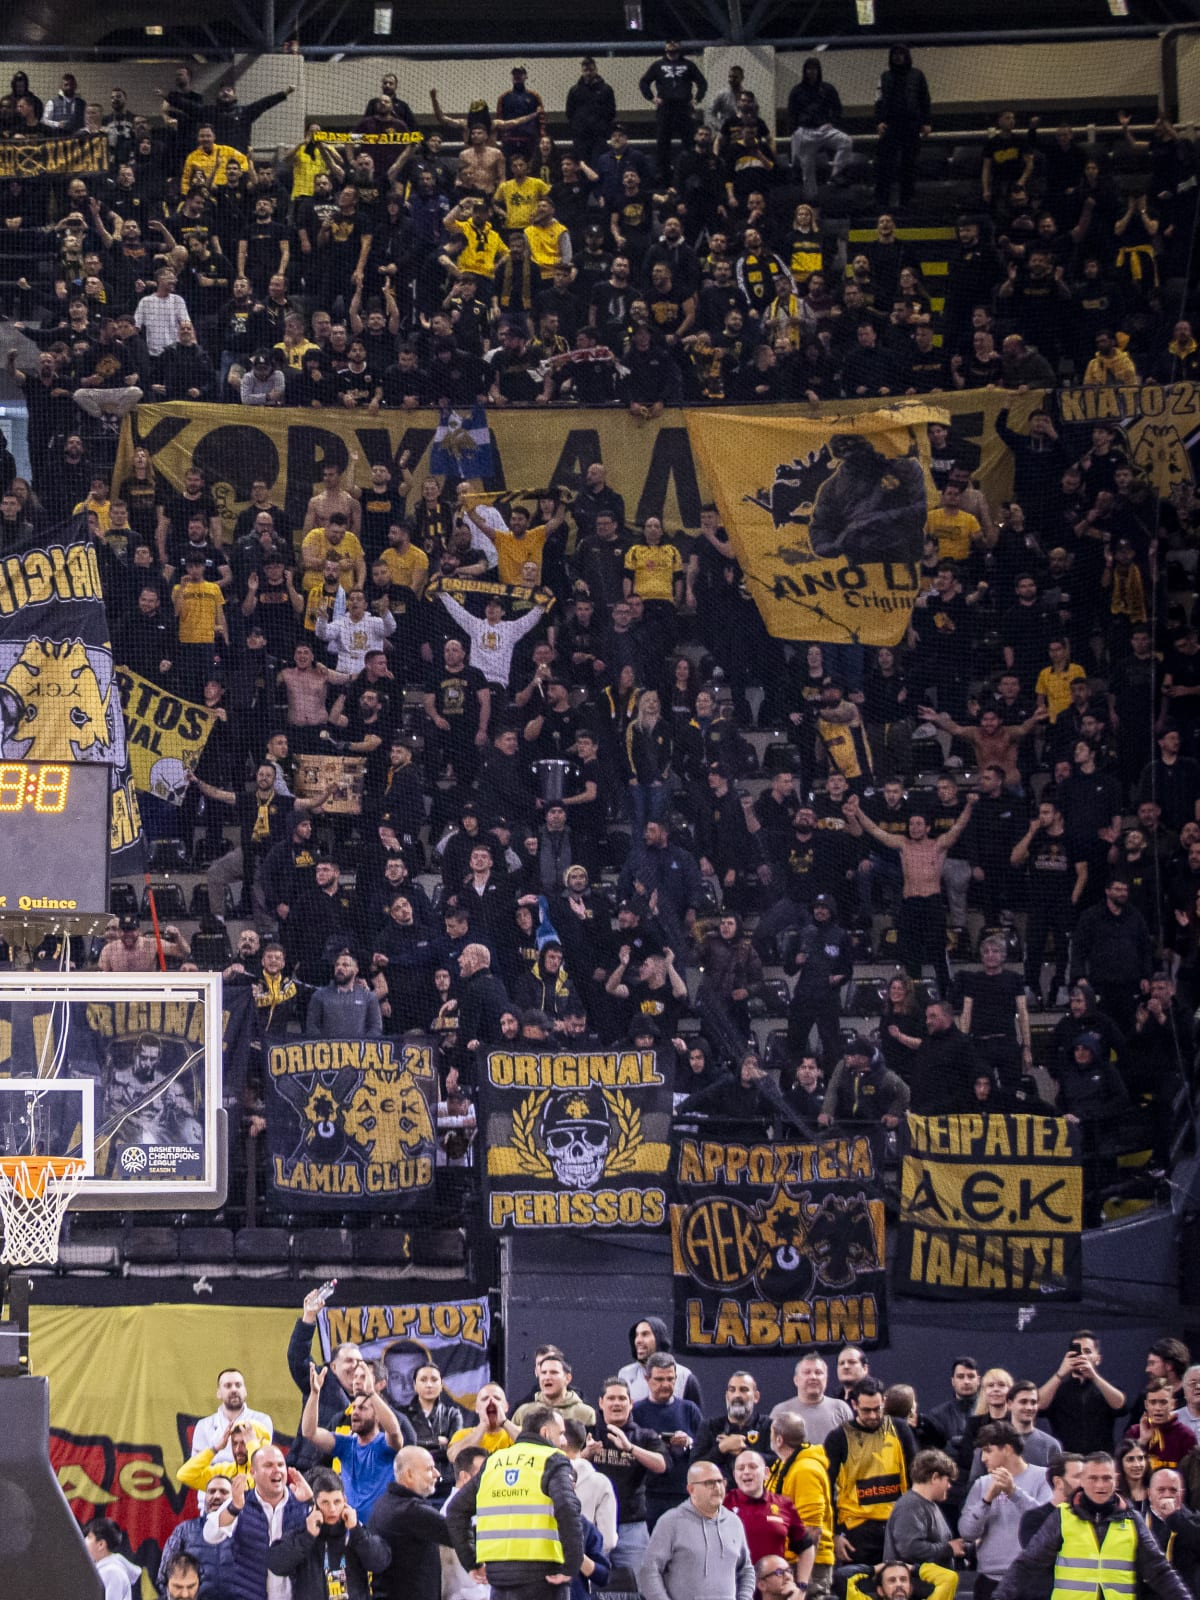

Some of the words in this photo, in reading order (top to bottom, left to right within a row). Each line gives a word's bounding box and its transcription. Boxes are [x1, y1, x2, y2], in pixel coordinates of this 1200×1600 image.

[1062, 386, 1165, 421] KIATO
[772, 566, 868, 600] ANO
[18, 896, 77, 910] Quince
[269, 1042, 398, 1076] ORIGINAL
[404, 1046, 434, 1078] 21
[489, 1052, 664, 1088] ORIGINAL
[907, 1113, 1074, 1158] ΠΕΙΡΑΤΕΣ
[274, 1156, 362, 1194] LAMIA
[365, 1158, 433, 1193] CLUB
[680, 1137, 872, 1184] ΑΡΡΩΣΤΕΙΑ
[491, 1189, 665, 1226] PERISSOS
[326, 1302, 487, 1350] ΜΑΡΙΟΣ
[686, 1297, 879, 1346] LABRINI
[493, 1454, 536, 1470] ALFA
[491, 1487, 530, 1498] SECURITY
